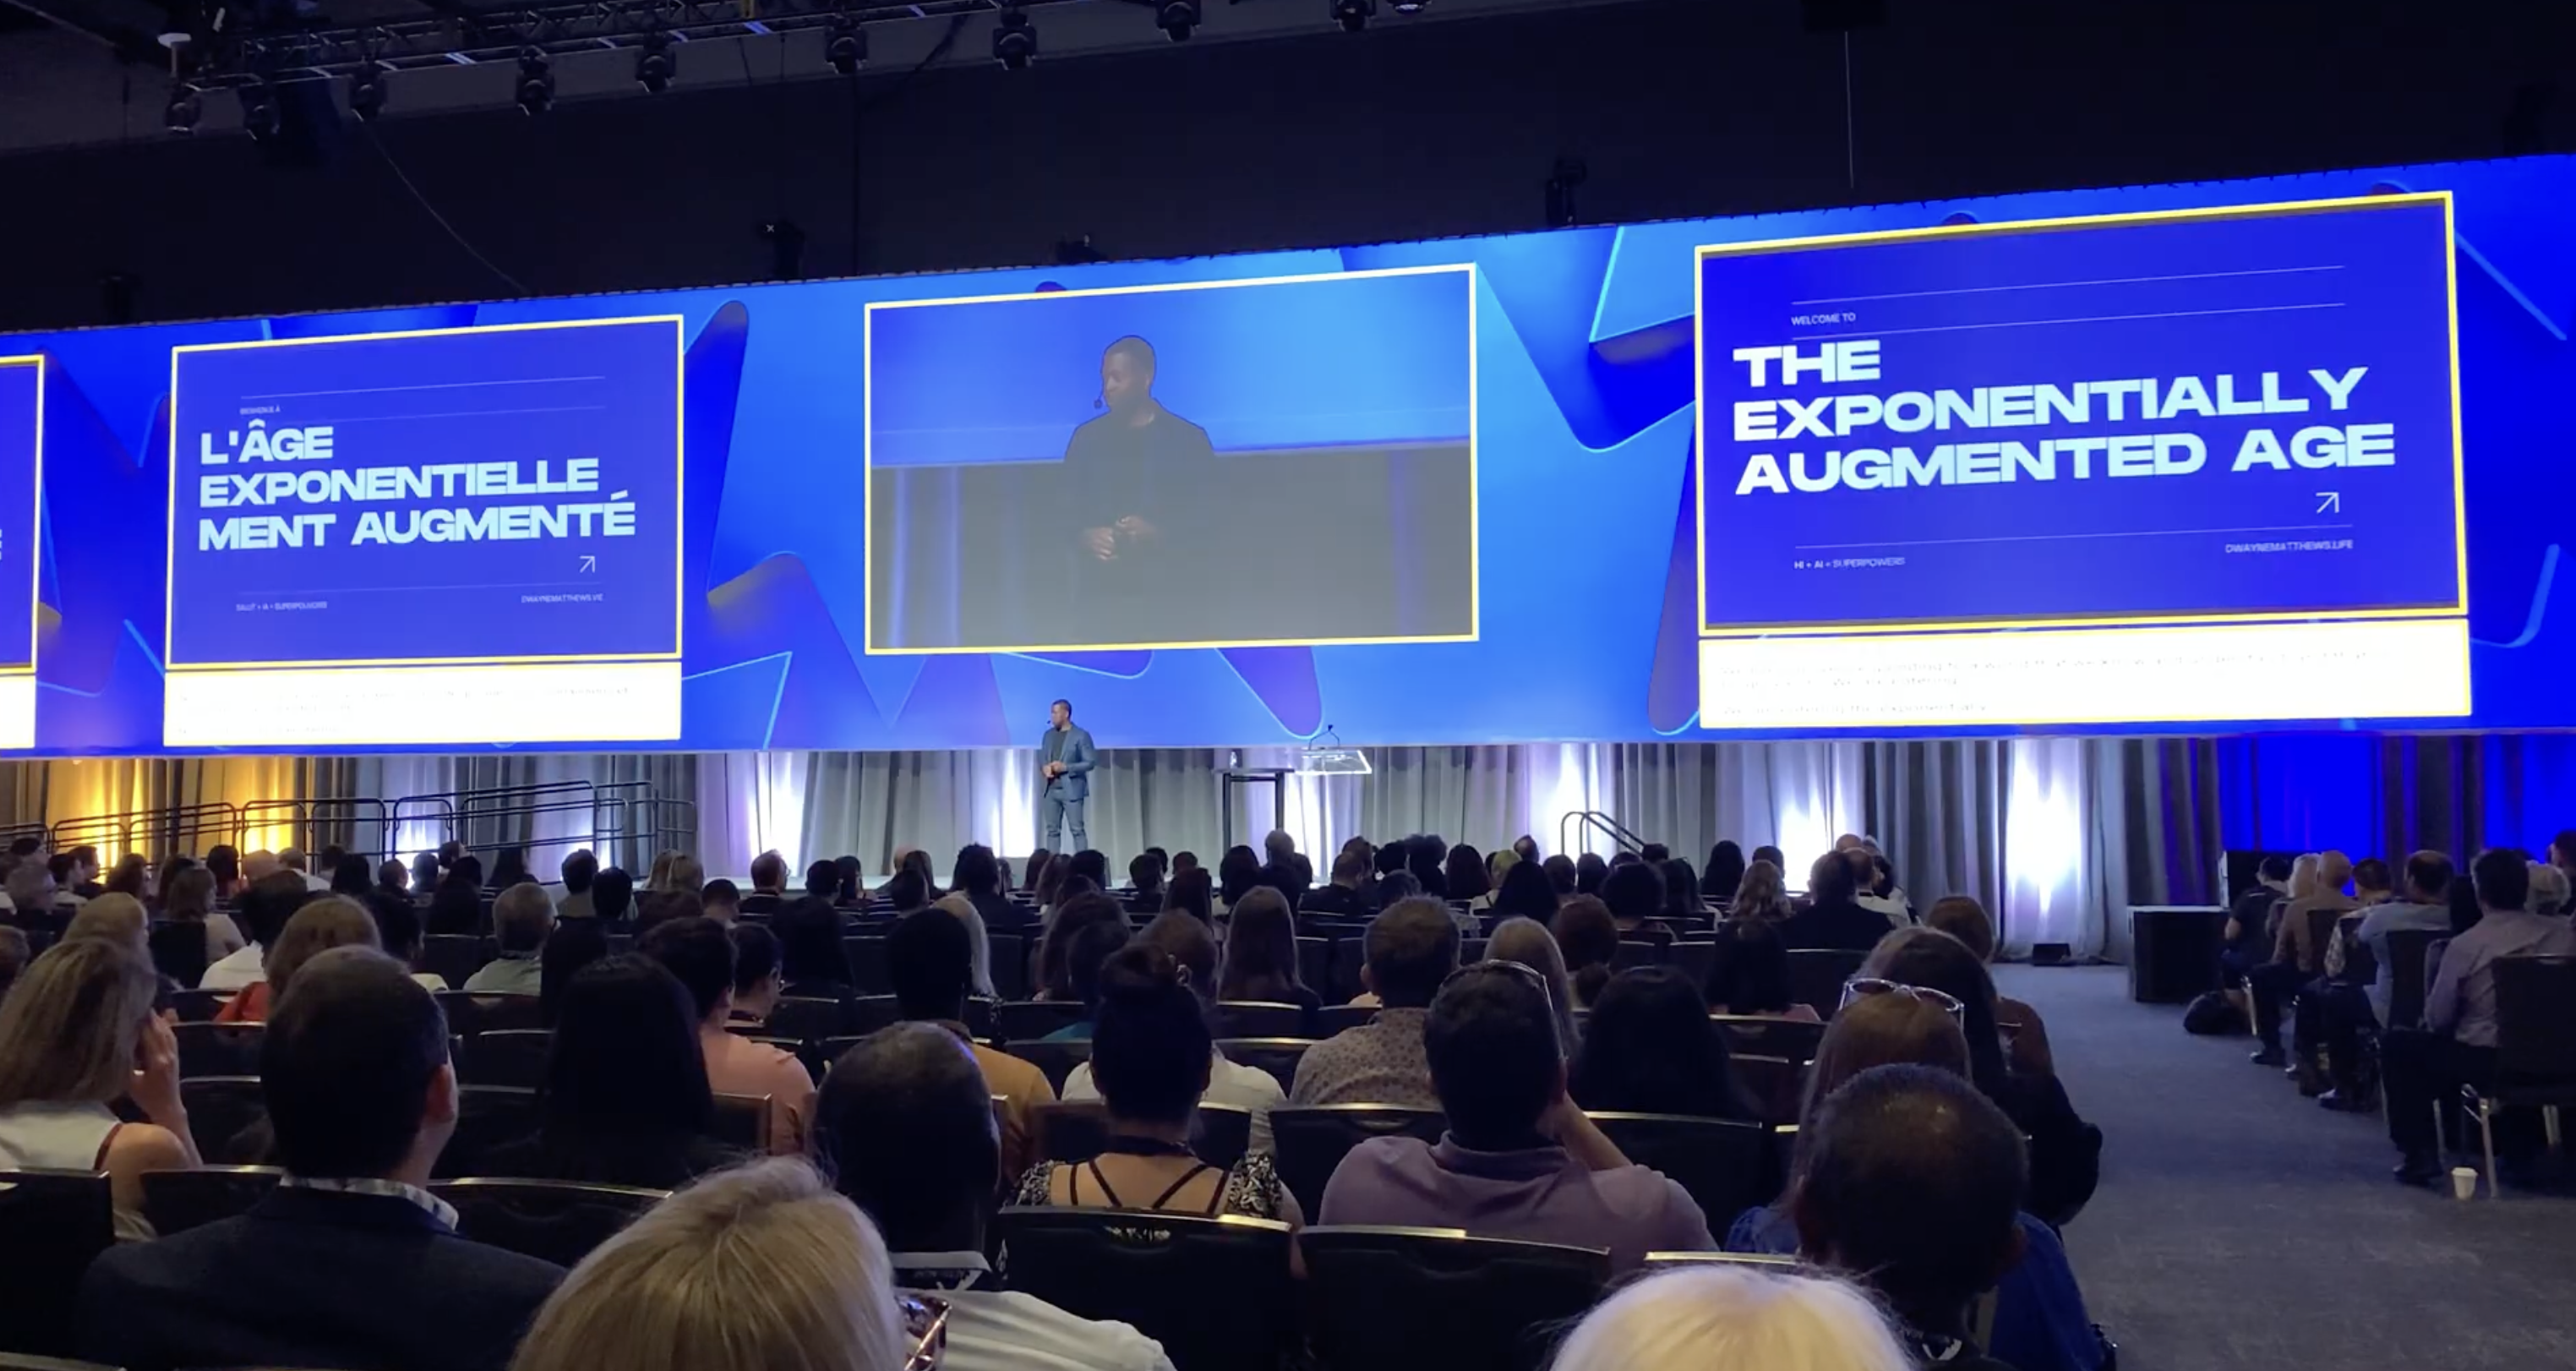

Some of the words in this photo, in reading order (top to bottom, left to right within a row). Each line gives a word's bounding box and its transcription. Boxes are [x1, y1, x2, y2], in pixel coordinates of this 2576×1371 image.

[1790, 313, 1840, 326] WELCOME
[1842, 312, 1857, 322] TO
[1733, 340, 1880, 387] THE
[1733, 367, 2368, 442] EXPONENTIALLY
[201, 418, 334, 465] L'ÂGE
[1735, 433, 2207, 495] AUGMENTED
[2231, 423, 2395, 472] AGE
[199, 457, 599, 508] EXPONENTIELLE
[199, 513, 336, 551] MENT
[351, 489, 636, 545] AUGMENTÉ
